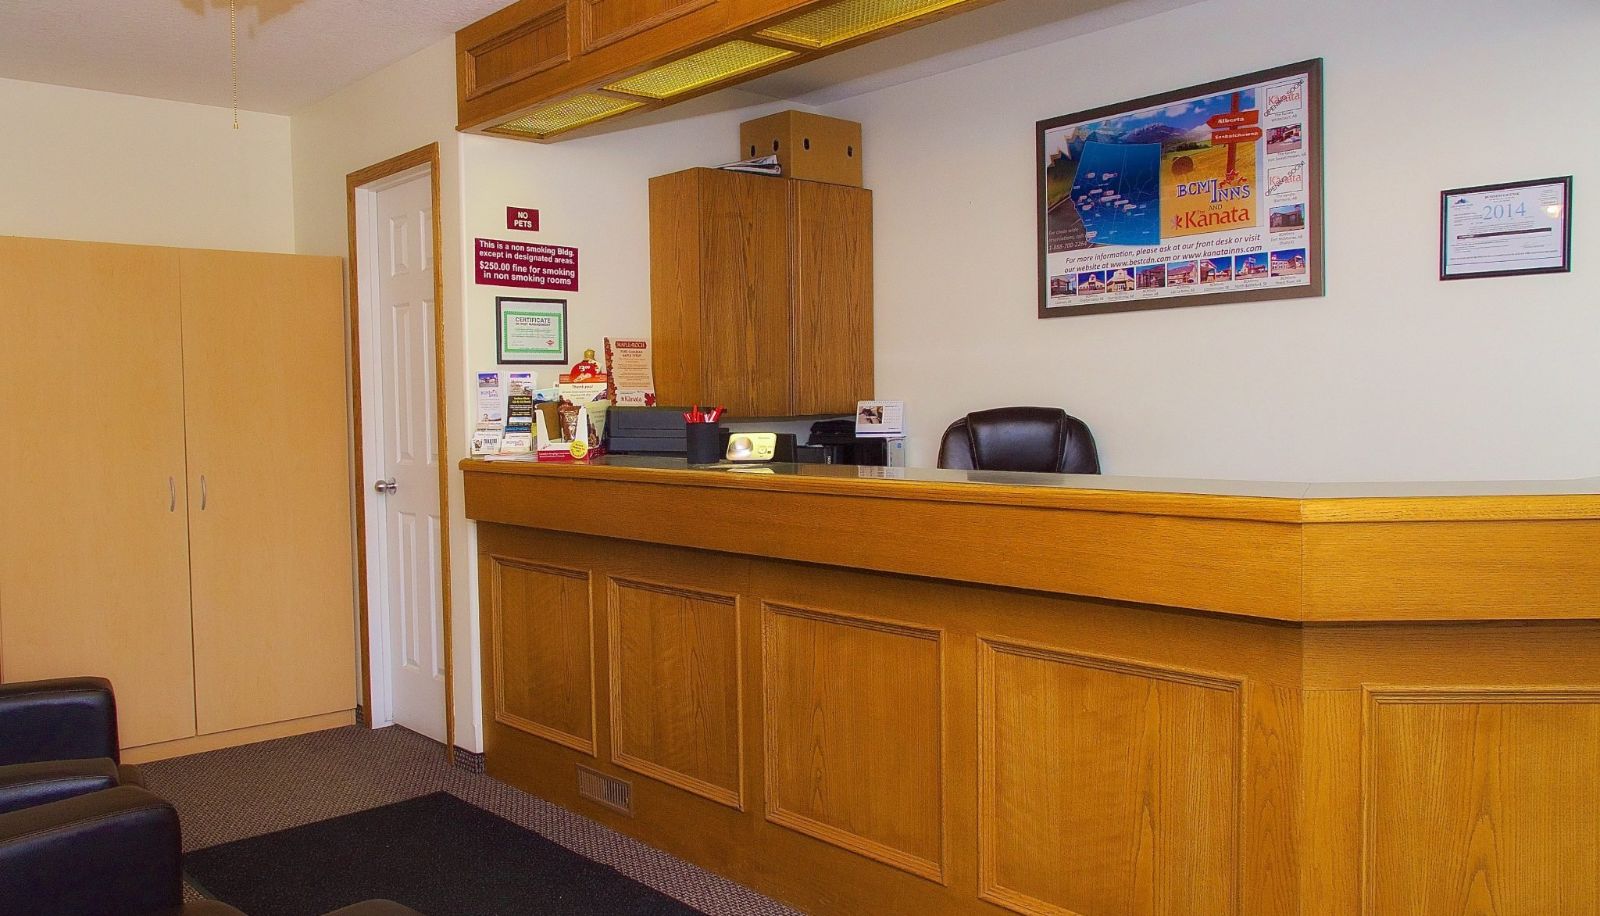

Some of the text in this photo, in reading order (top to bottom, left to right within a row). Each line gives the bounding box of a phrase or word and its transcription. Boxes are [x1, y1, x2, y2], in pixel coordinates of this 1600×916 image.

[518, 211, 528, 219] NO
[1185, 207, 1250, 228] Kanata
[1483, 202, 1527, 219] 2014
[514, 219, 532, 228] PETS
[480, 240, 495, 249] This
[526, 246, 556, 256] smoking
[557, 248, 575, 257] Bldg.
[1095, 250, 1134, 261] information,
[1136, 247, 1158, 256] please
[1159, 244, 1171, 252] ask
[1195, 239, 1214, 250] front
[1216, 237, 1232, 246] desk
[1245, 234, 1261, 242] visit
[479, 250, 575, 265] except in designated areas.
[1077, 262, 1101, 272] website
[1110, 256, 1171, 267] www.bestcdn.com
[1182, 245, 1262, 260] www.kanatainns.com
[480, 260, 575, 278] $250.00 fine for smoking
[493, 272, 509, 280] non
[511, 273, 545, 284] smoking
[547, 277, 572, 285] rooms
